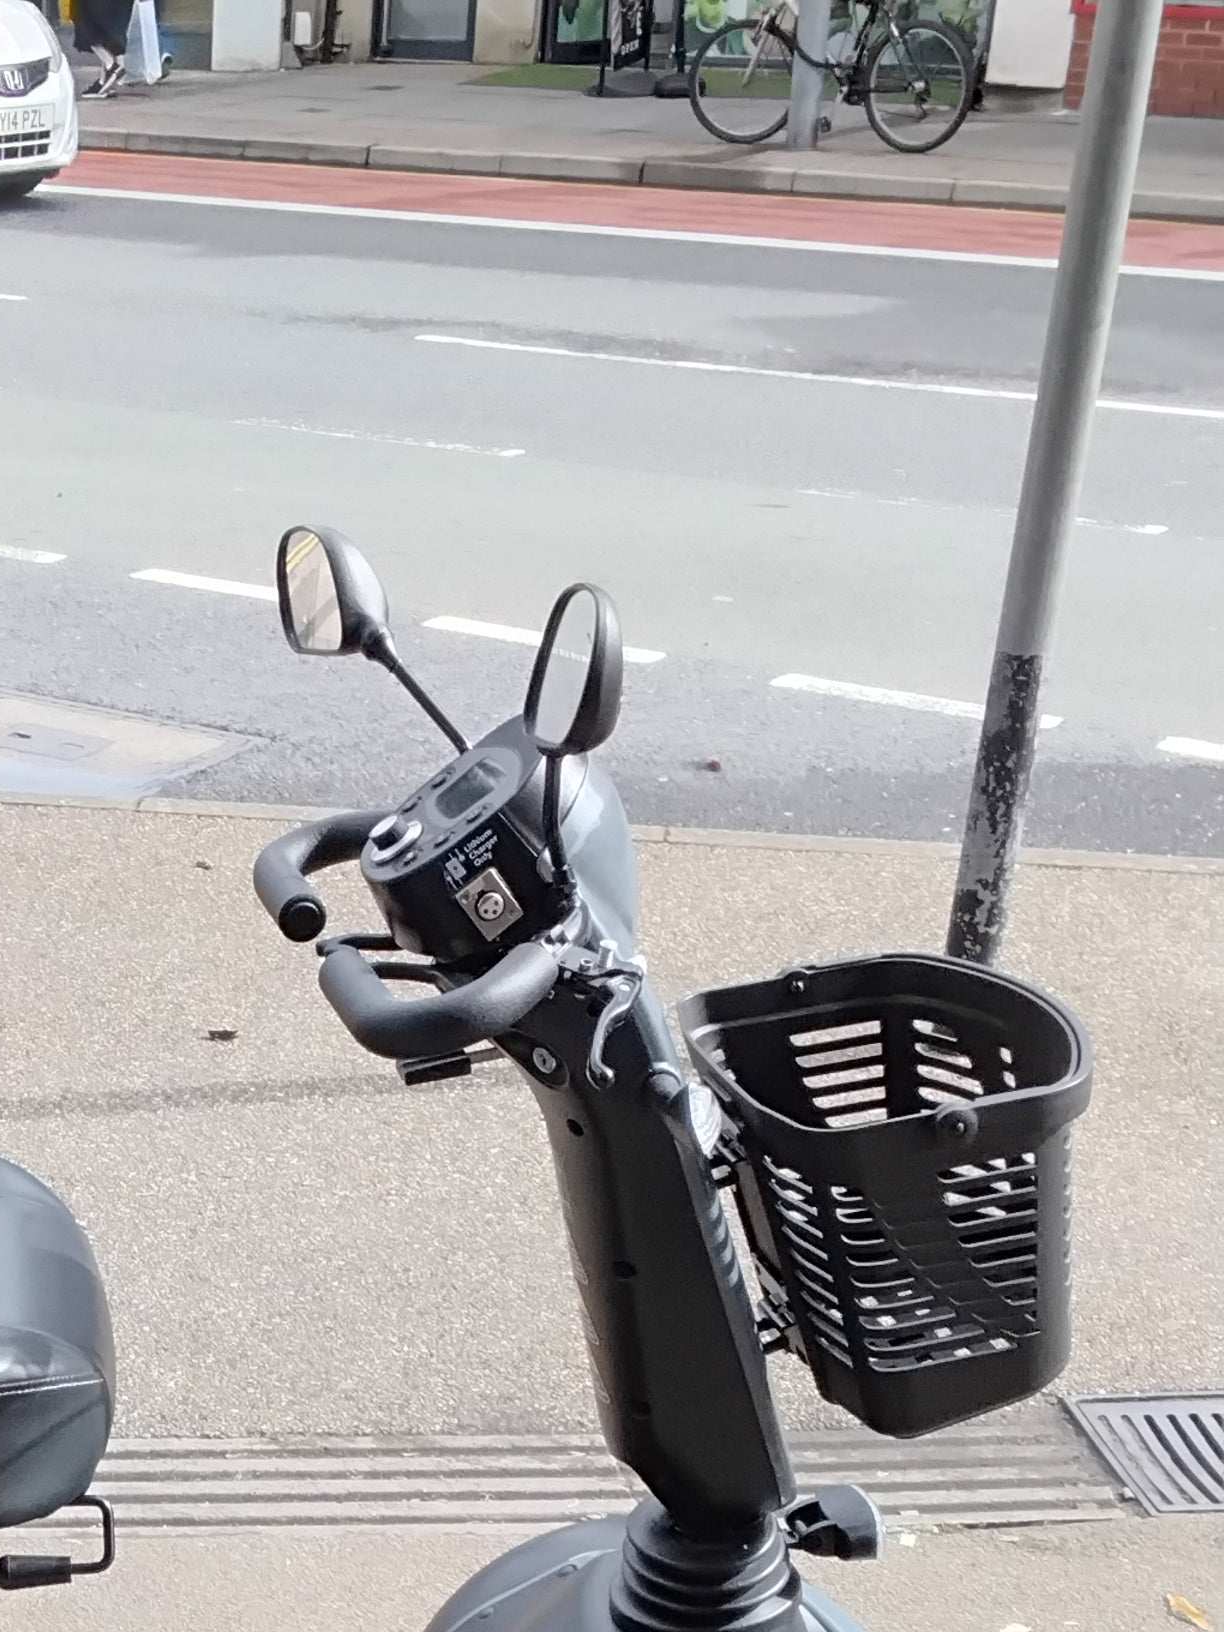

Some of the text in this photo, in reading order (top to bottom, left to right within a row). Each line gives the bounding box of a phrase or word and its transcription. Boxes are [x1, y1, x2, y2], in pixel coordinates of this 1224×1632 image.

[22, 109, 46, 130] PZL
[463, 828, 494, 853] Lithium
[468, 834, 499, 860] Charger
[473, 851, 493, 866] Only
